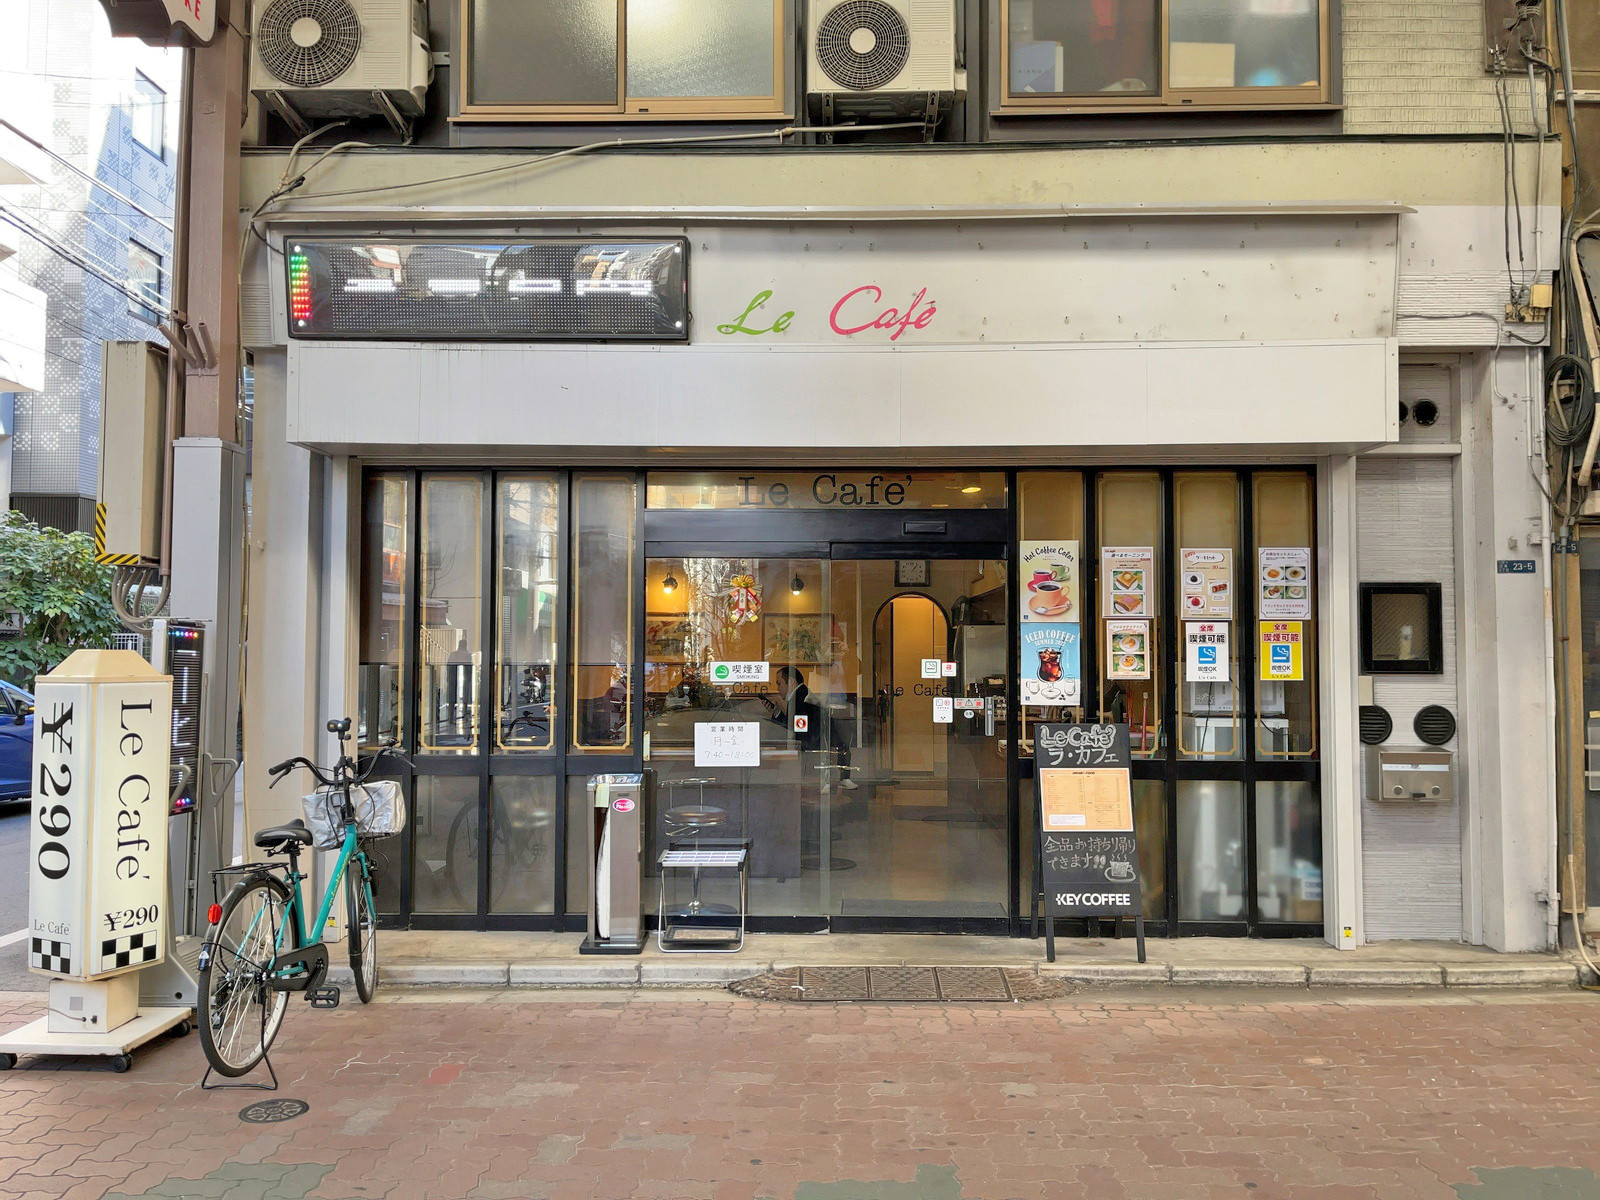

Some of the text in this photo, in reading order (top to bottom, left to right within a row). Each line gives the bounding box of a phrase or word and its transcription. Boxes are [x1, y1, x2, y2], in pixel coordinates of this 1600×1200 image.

[716, 285, 937, 341] Le Café
[738, 476, 789, 506] Le
[1023, 551, 1036, 563] Hot
[1035, 545, 1057, 555] Coffee
[1058, 547, 1075, 562] Color
[1557, 543, 1577, 551] 2-5
[1512, 562, 1533, 571] 23-5
[1199, 624, 1214, 632] 全席
[1273, 623, 1288, 631] 全席
[1024, 629, 1076, 643] ICED COFFEE
[1189, 633, 1226, 643] 喫煙可能
[1263, 633, 1300, 643] 喫煙可能
[732, 664, 763, 674] 喫煙室
[119, 699, 152, 757] Le
[1048, 746, 1119, 765] ラ・カフェ
[38, 702, 74, 880] ¥290
[1044, 835, 1136, 854] 全品お持ち帰り
[34, 918, 45, 932] Le
[103, 904, 159, 932] ¥290
